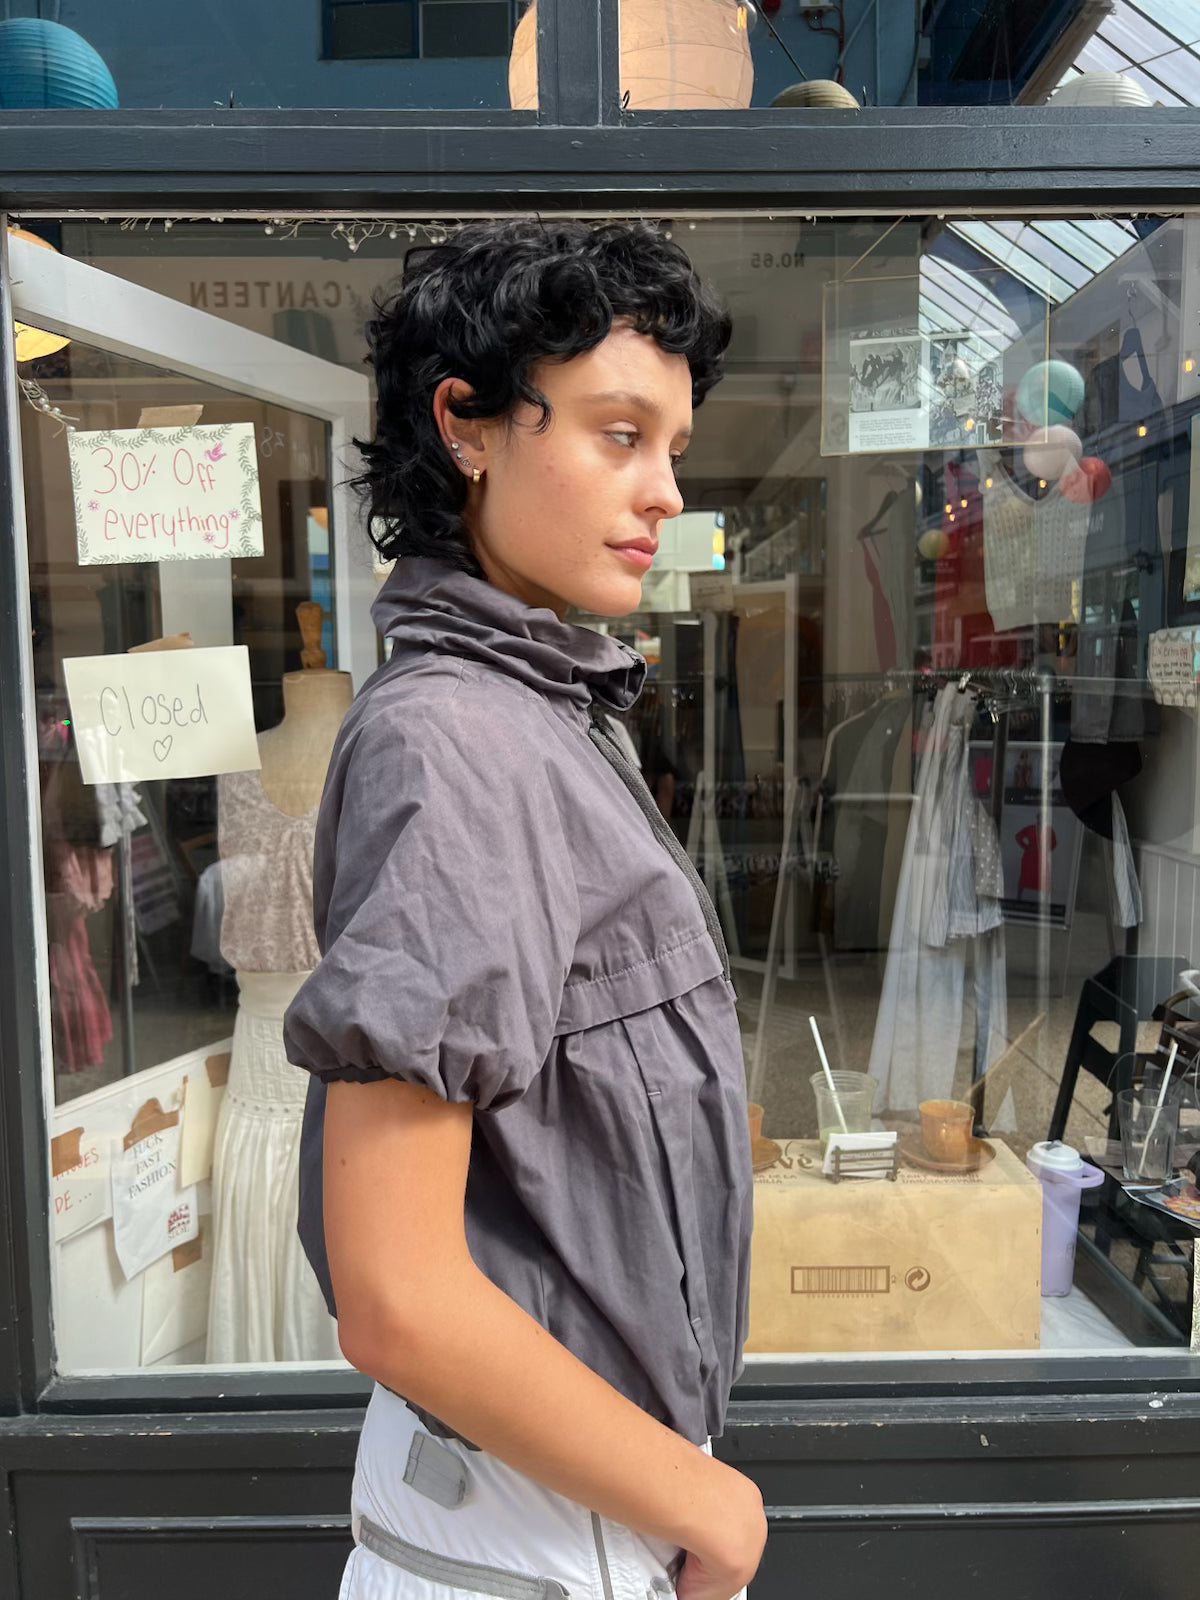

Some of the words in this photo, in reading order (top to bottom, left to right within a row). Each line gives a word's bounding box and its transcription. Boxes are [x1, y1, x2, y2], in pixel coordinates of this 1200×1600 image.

[91, 447, 157, 494] 30%
[173, 448, 216, 493] Off
[104, 506, 229, 549] everything
[100, 683, 208, 736] Closed
[128, 1159, 177, 1199] FASHION
[135, 1149, 163, 1175] FAST
[55, 1189, 74, 1215] DE
